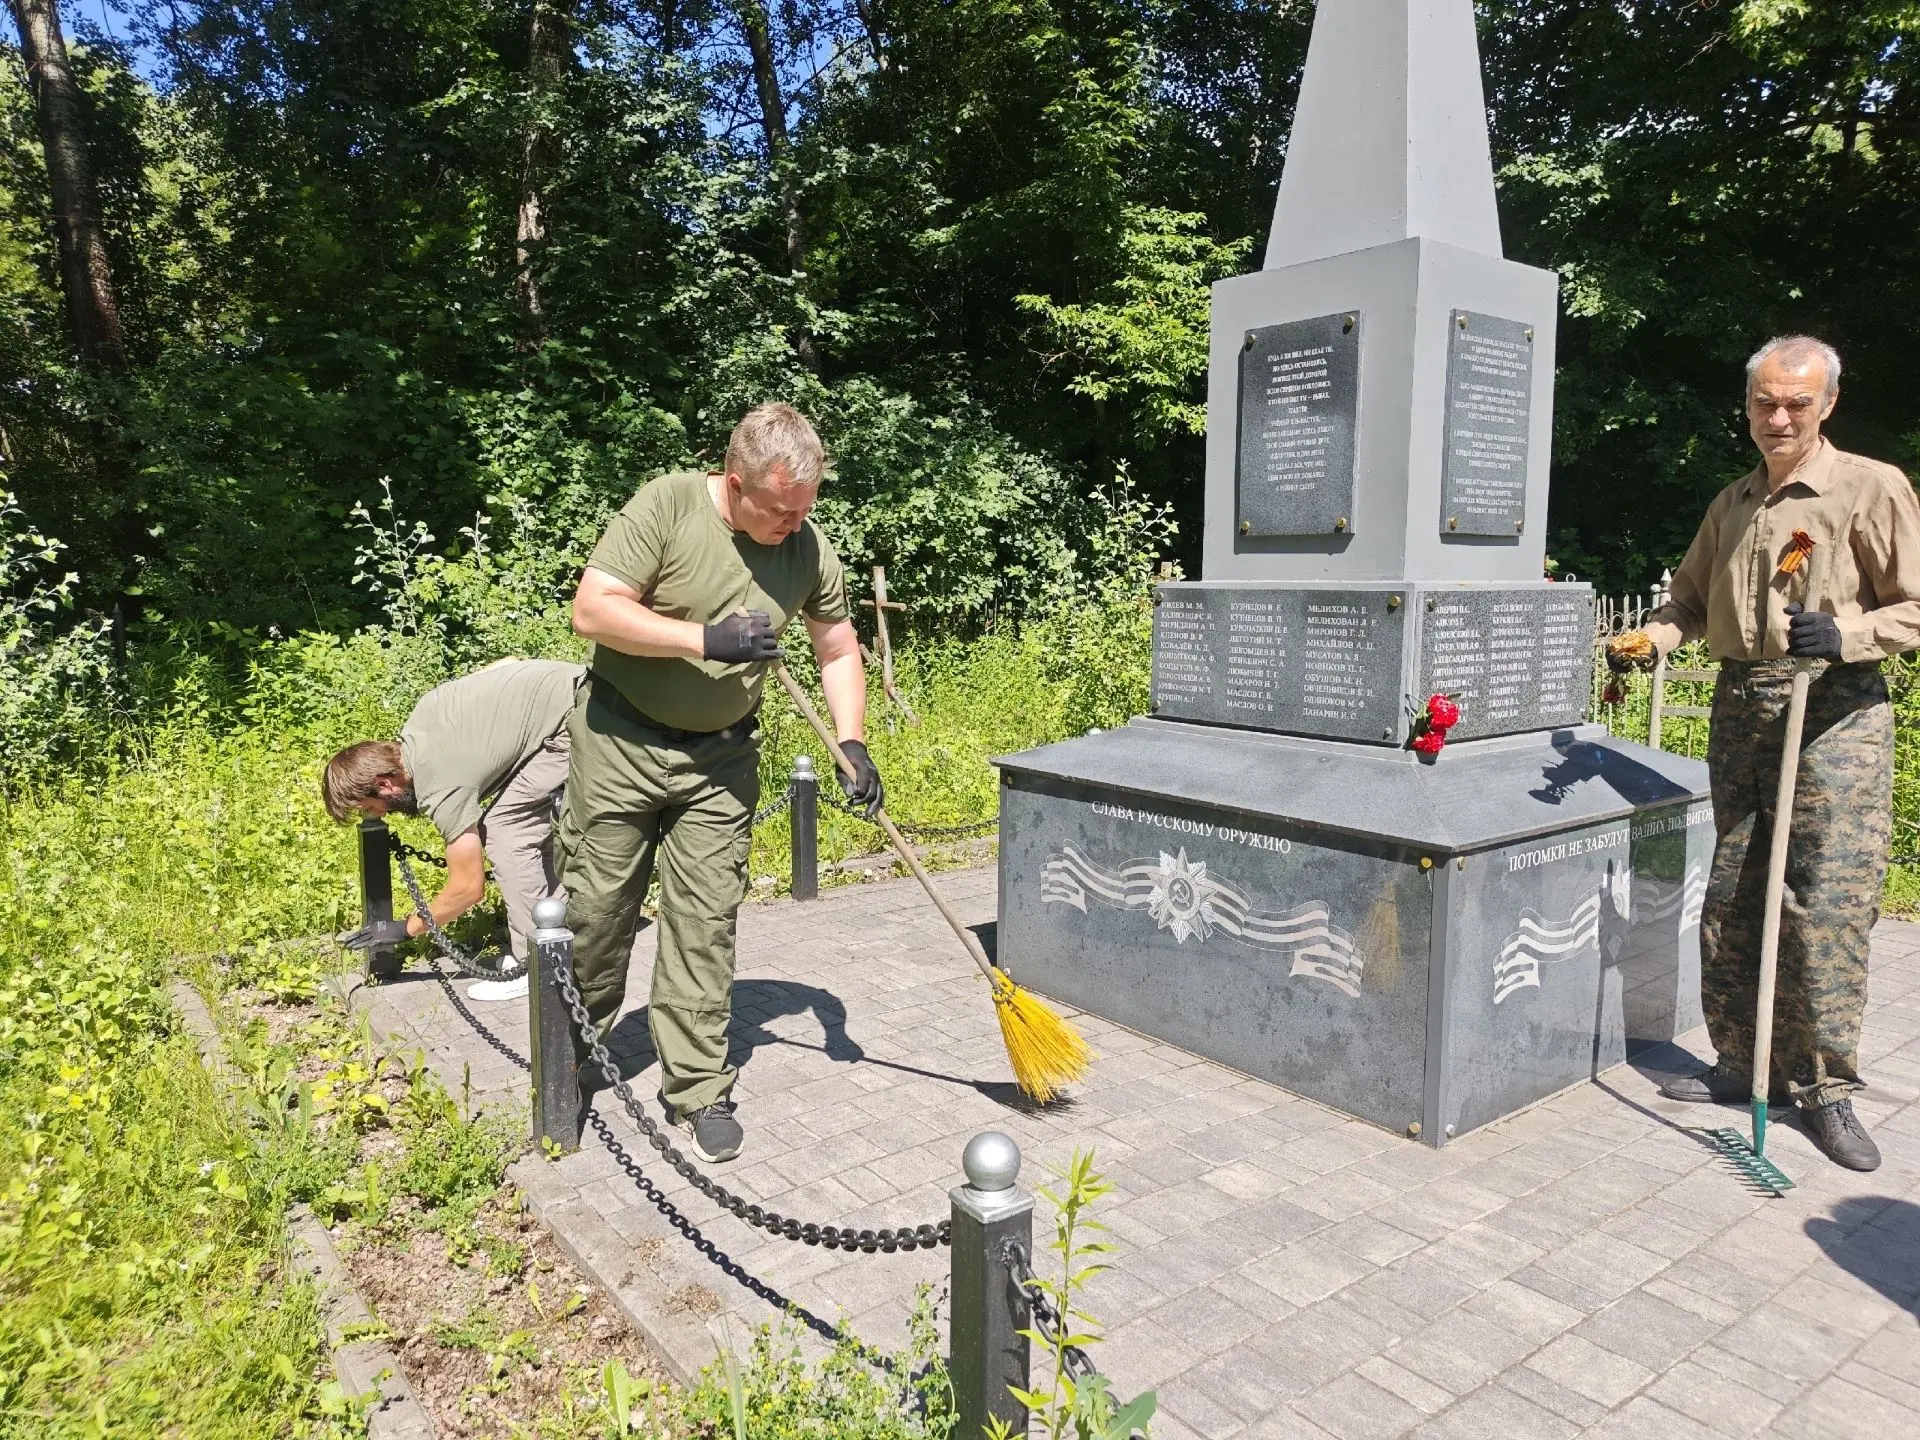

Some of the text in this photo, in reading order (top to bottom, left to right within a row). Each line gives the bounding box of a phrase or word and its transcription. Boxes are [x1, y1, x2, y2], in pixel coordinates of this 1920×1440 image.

[1230, 602, 1267, 611] КУЗНЕЦОВ
[1308, 605, 1348, 614] МЕЛИХОВ
[1350, 606, 1359, 614] А.
[1230, 614, 1266, 622] КУЗНЕЦОВ
[1307, 616, 1359, 626] МЕЛИХОВАН
[1371, 619, 1379, 627] Е.
[1307, 628, 1366, 638] МИРОНОВ Г. Л.
[1160, 641, 1193, 650] КОВАЛЁВ
[1306, 638, 1376, 650] МИХАЙЛОВ А. П.
[1208, 655, 1216, 663] Ф.
[1305, 650, 1342, 660] МУСАТОВ
[1269, 659, 1277, 667] С.
[1305, 662, 1346, 672] НОВИКОВ
[1348, 664, 1357, 673] П.
[1228, 676, 1263, 687] МАКАРОВ
[1226, 688, 1257, 698] МАСЛОВ
[1226, 700, 1257, 710] МАСЛОВ
[1303, 696, 1346, 706] ОДИНОКОВ
[1358, 700, 1368, 708] Ф.
[1302, 707, 1339, 718] ПАНАРИН
[1091, 800, 1292, 854] СЛАВА РУССКОМУ ОРУЖИЮ
[1509, 807, 1714, 872] ПОТОМКИ НЕ ЗАБУДУТ ВАШИХ ПОДВИГОВ
